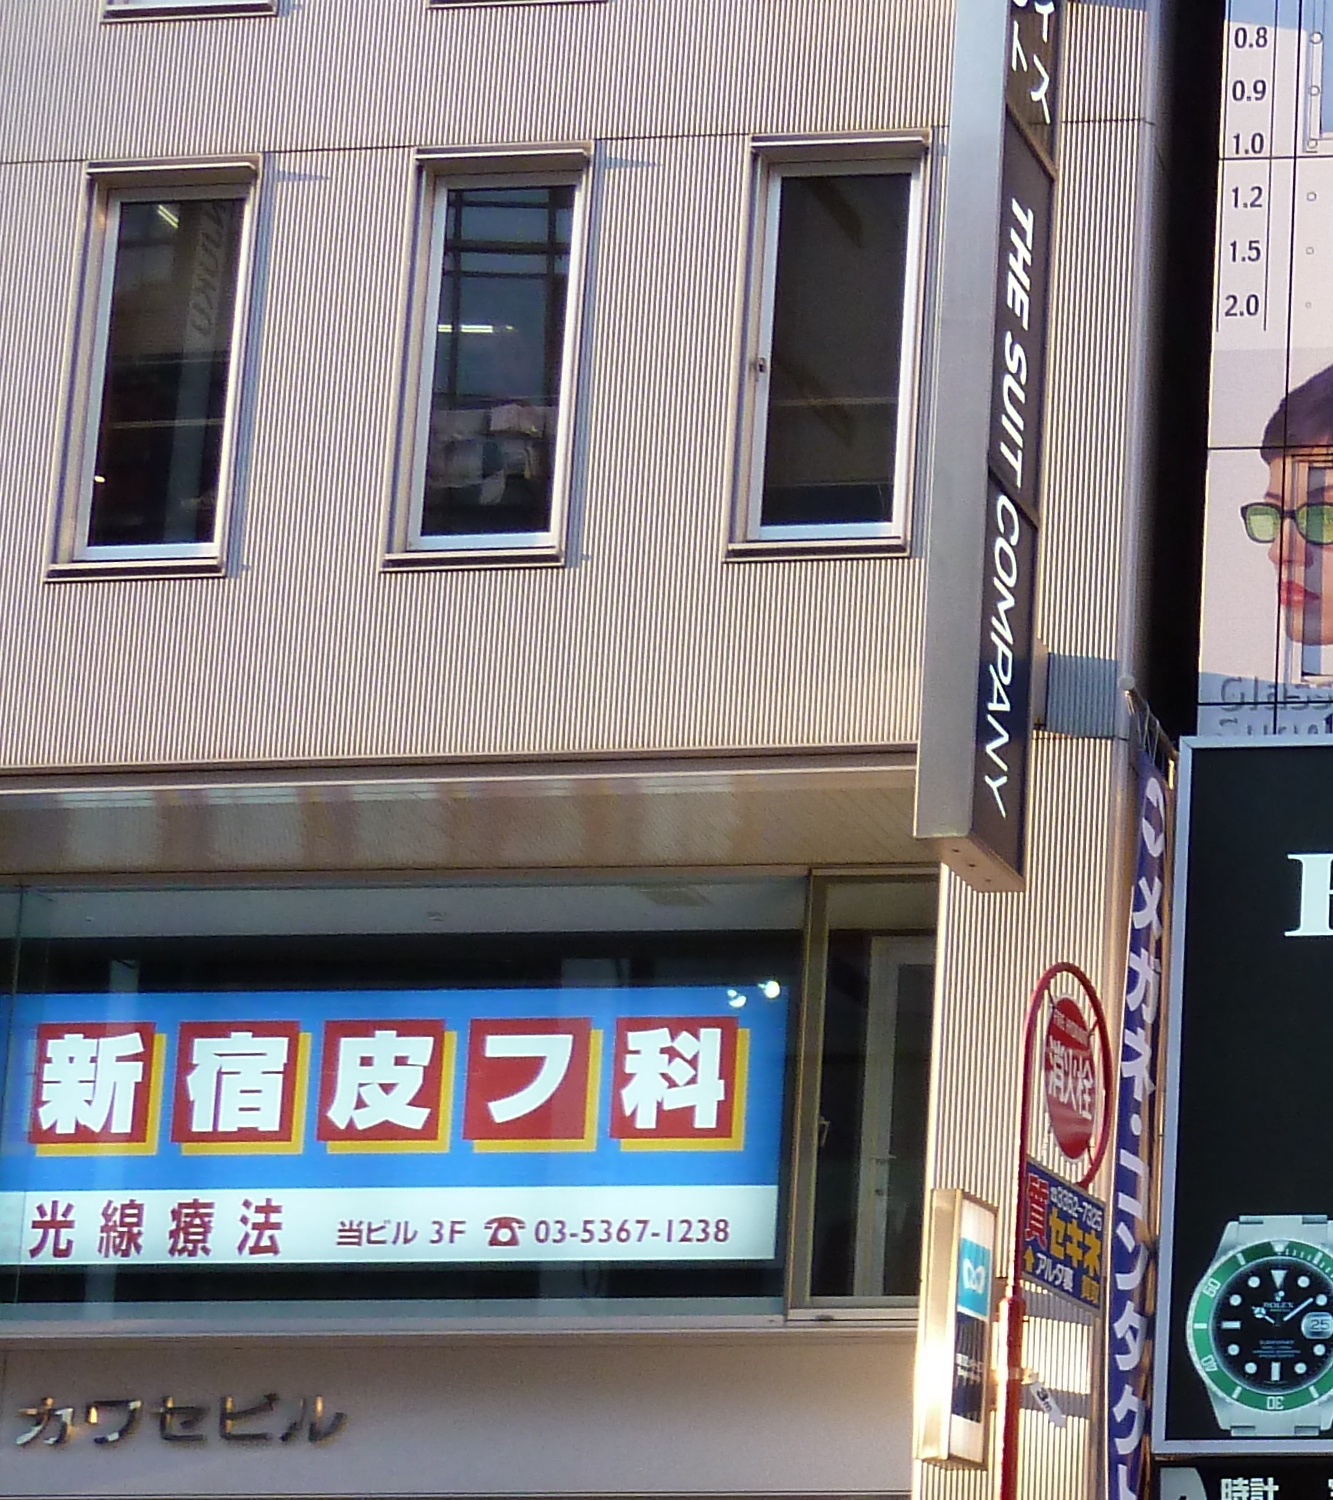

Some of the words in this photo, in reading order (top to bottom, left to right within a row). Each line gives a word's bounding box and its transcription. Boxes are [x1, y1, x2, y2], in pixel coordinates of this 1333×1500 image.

[1234, 26, 1268, 49] 0.8
[1232, 78, 1266, 101] 0.9
[1232, 132, 1264, 155] 1.0
[1231, 186, 1263, 209] 1.2
[1007, 198, 1034, 330] THE
[1229, 240, 1261, 263] 1.5
[1225, 294, 1259, 318] 2.0
[998, 331, 1027, 488] SUIT
[985, 494, 1020, 818] COMPANY
[37, 1027, 726, 1135] 新宿皮フ科
[29, 1198, 283, 1260] 光線療法
[1025, 1173, 1049, 1250] 質
[336, 1218, 418, 1248] 当ビル
[429, 1220, 467, 1245] 3F
[534, 1219, 731, 1246] 03-5367-1238
[1050, 1206, 1101, 1277] セキネ
[1310, 1320, 1330, 1332] 25
[15, 1395, 348, 1448] カワセビル
